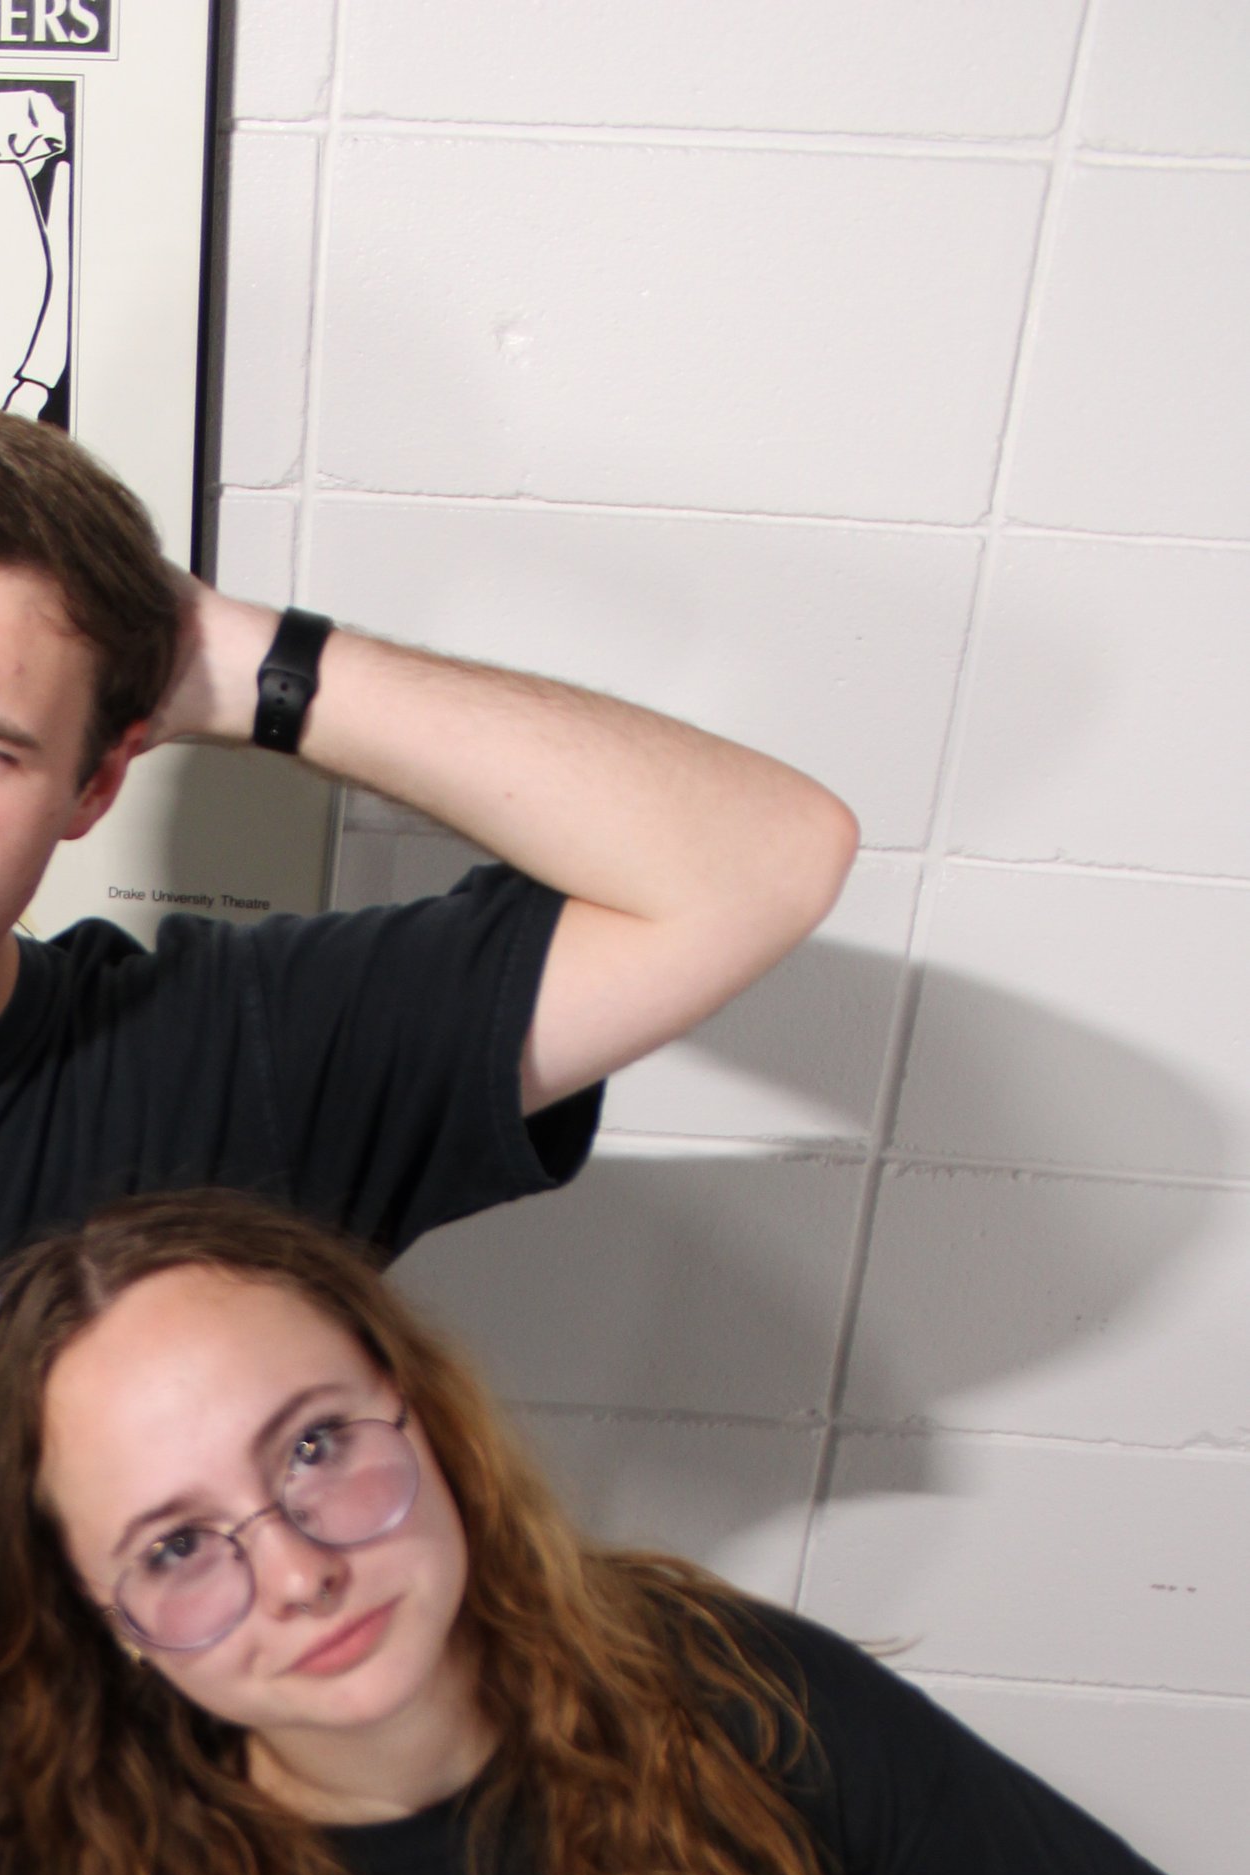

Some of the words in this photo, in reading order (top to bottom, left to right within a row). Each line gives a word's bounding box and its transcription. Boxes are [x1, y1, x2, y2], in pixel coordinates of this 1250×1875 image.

[108, 886, 146, 900] Drake
[152, 889, 215, 909] University
[221, 894, 271, 910] Theatre
